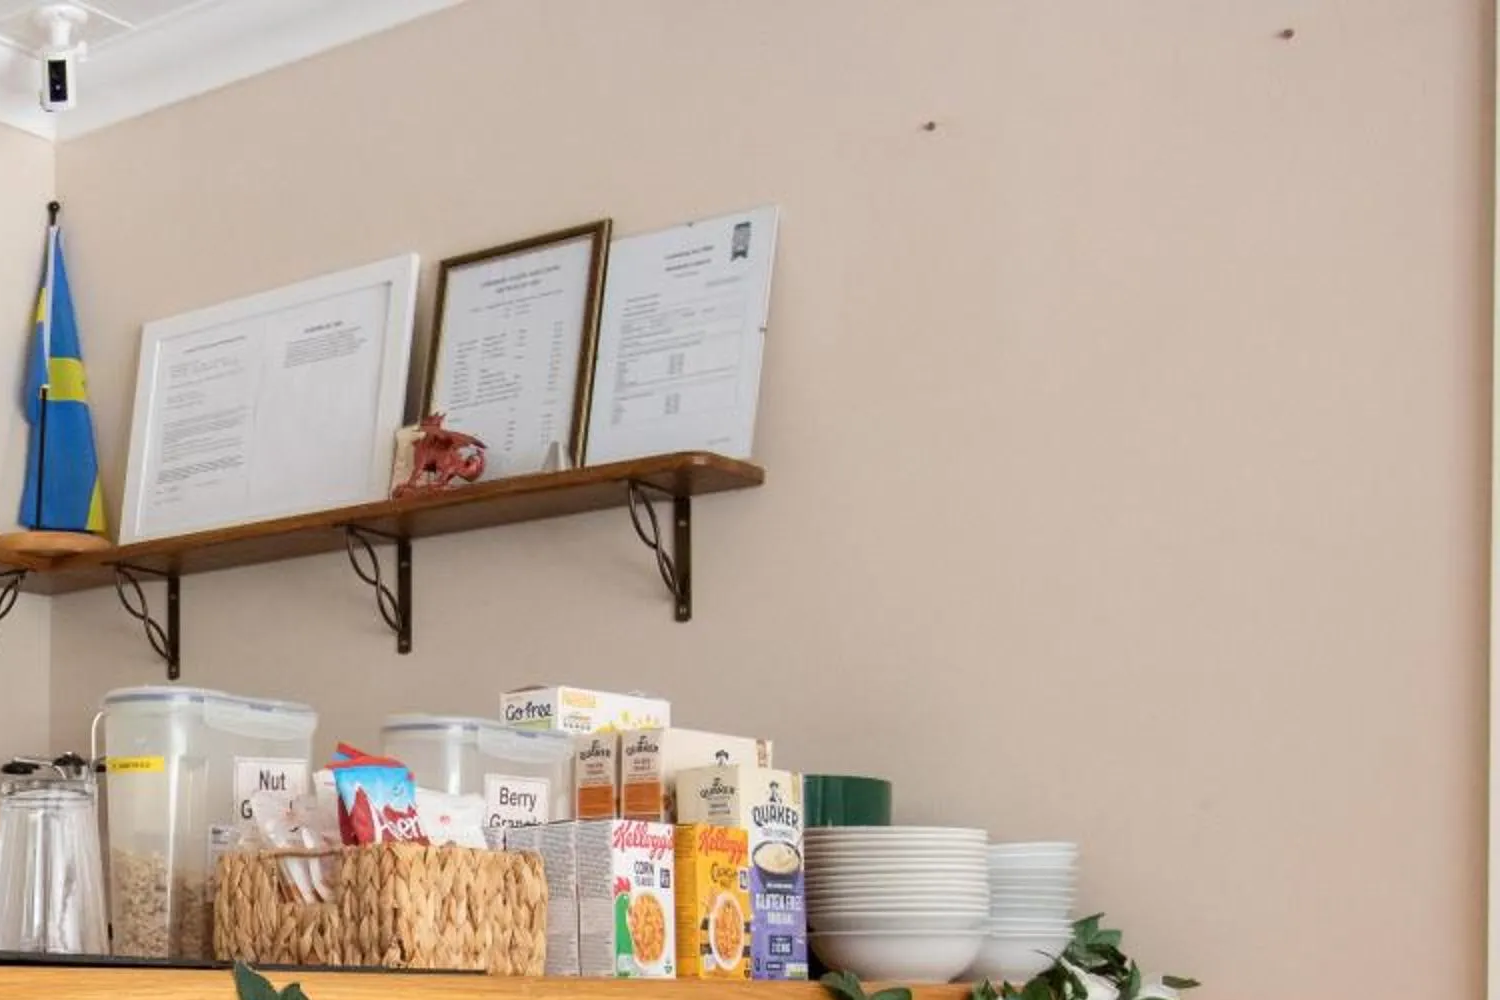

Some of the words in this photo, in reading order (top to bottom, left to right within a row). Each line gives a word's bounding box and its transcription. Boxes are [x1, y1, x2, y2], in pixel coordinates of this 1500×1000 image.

[504, 703, 522, 721] Go
[259, 769, 287, 791] Nut
[499, 786, 537, 812] Berry
[752, 804, 799, 830] QUAKER
